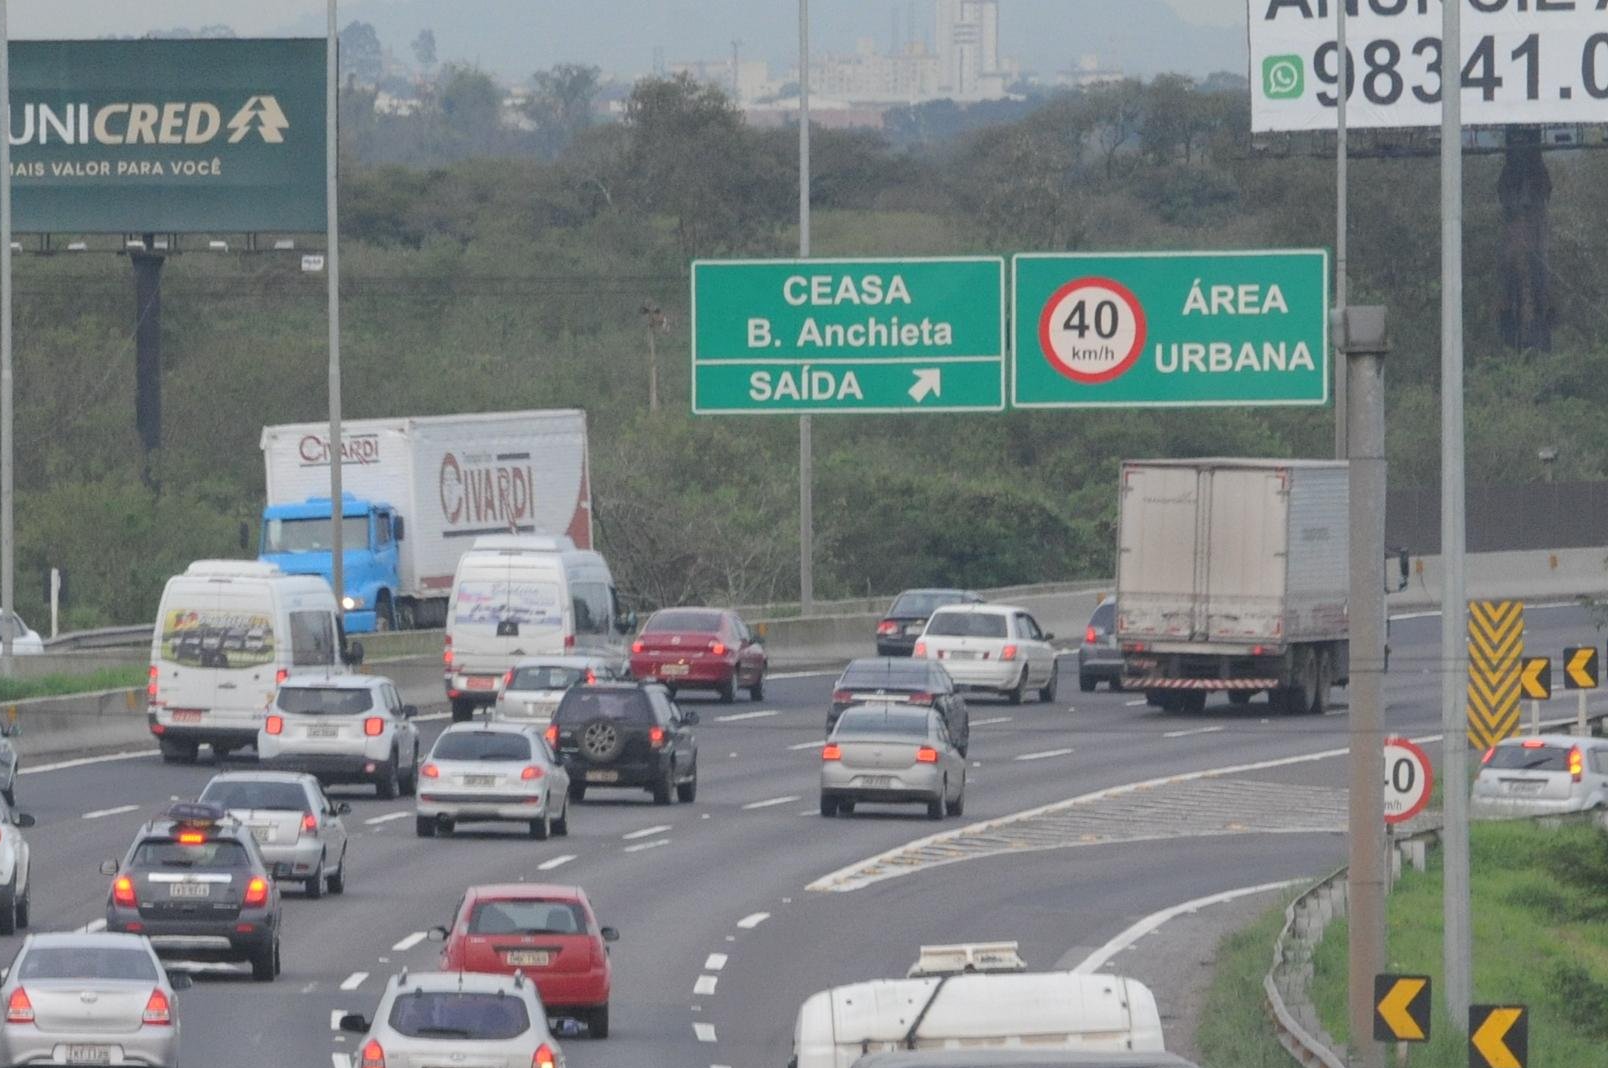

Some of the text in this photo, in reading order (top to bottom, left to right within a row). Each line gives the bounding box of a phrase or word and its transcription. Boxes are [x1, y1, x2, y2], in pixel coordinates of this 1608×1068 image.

[8, 102, 221, 145] UNICRED
[9, 157, 221, 177] AIS VALOR PARA VOCÊ
[783, 274, 912, 305] CEASA
[1182, 278, 1289, 316] ÁREA
[747, 316, 953, 348] B. Anchieta
[1063, 299, 1119, 340] 40
[1071, 345, 1115, 362] km/h
[1154, 341, 1315, 374] URBANA
[749, 364, 864, 401] SAÍDA
